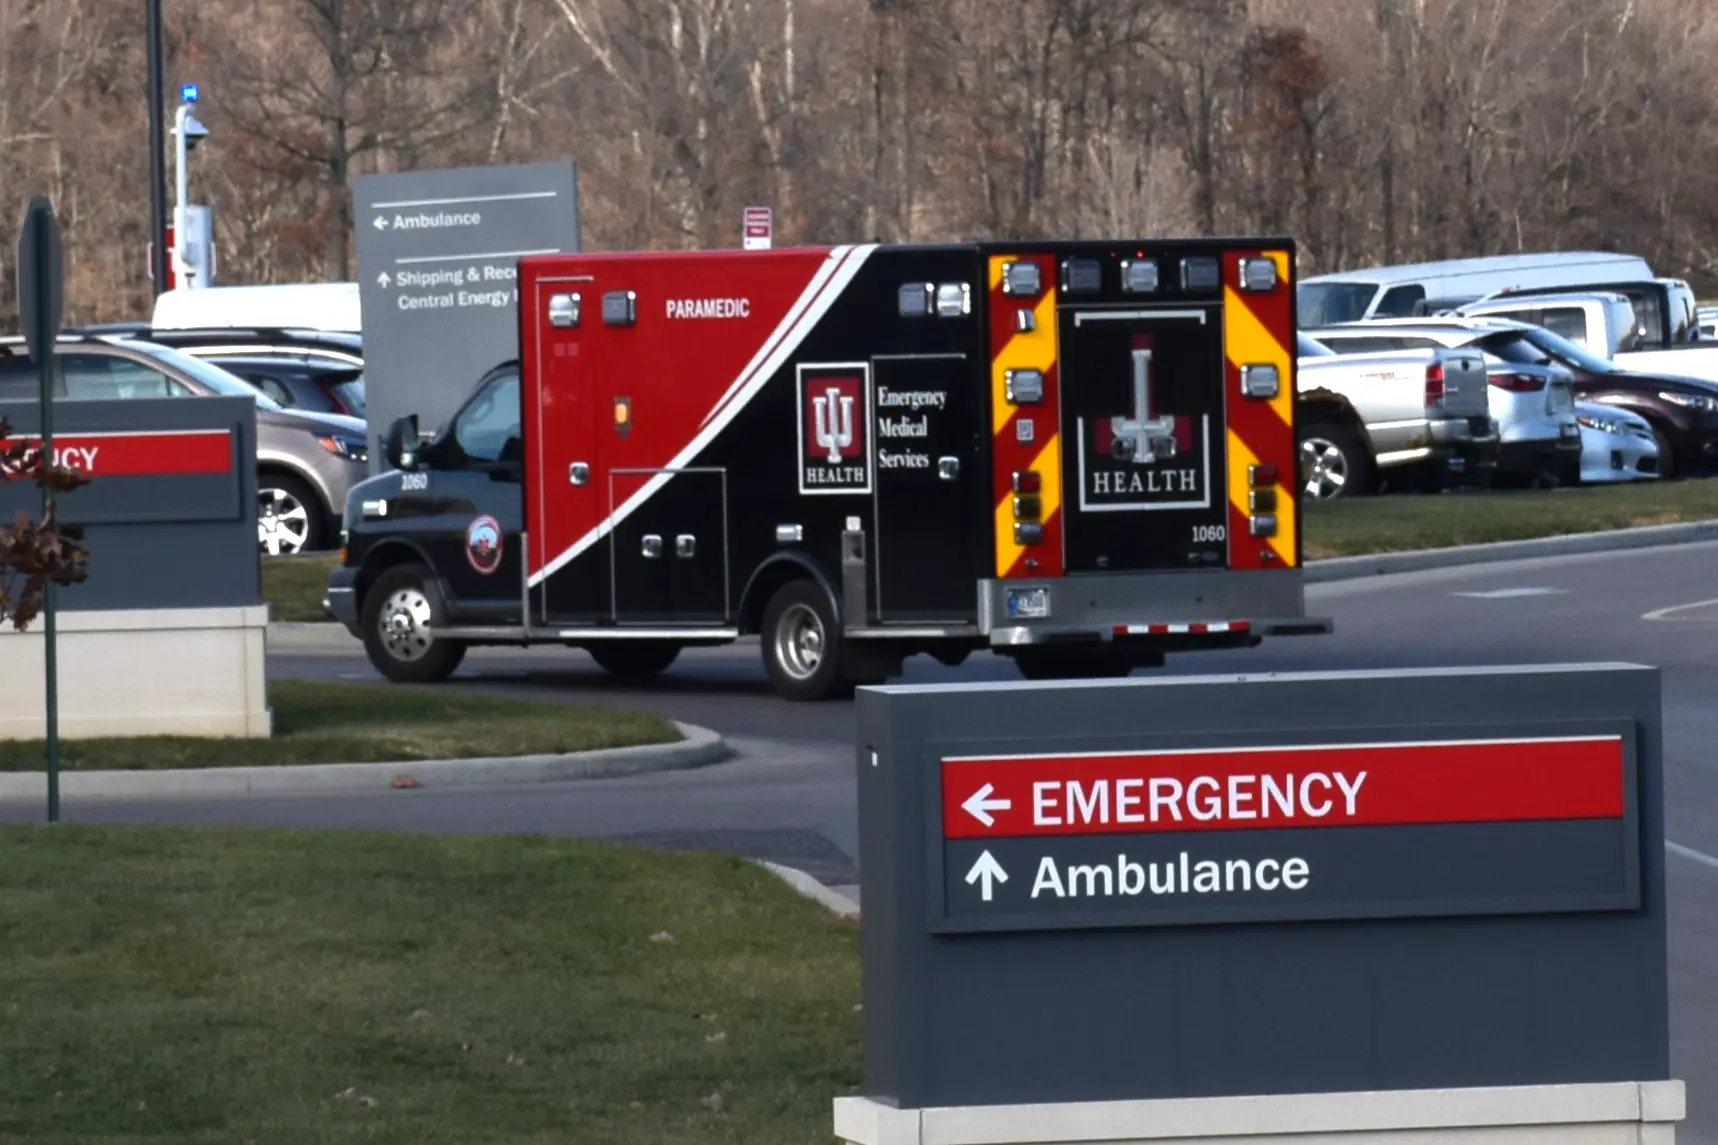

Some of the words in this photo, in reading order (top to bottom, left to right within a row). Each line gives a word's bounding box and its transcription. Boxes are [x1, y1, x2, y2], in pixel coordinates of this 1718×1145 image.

[393, 212, 481, 230] Ambulance
[396, 267, 463, 287] Shipping
[467, 267, 480, 281] &
[398, 294, 454, 310] Central
[459, 289, 510, 308] Energy
[666, 298, 750, 319] PARAMEDIC
[877, 386, 946, 410] Emergency
[878, 416, 928, 437] Medical
[878, 449, 929, 468] Services
[401, 473, 428, 490] 1060
[806, 467, 864, 483] HEALTH
[1093, 469, 1196, 494] HEALTH
[1192, 525, 1225, 542] 1060
[1032, 771, 1367, 826] EMERGENCY
[1030, 852, 1310, 898] Ambulance
